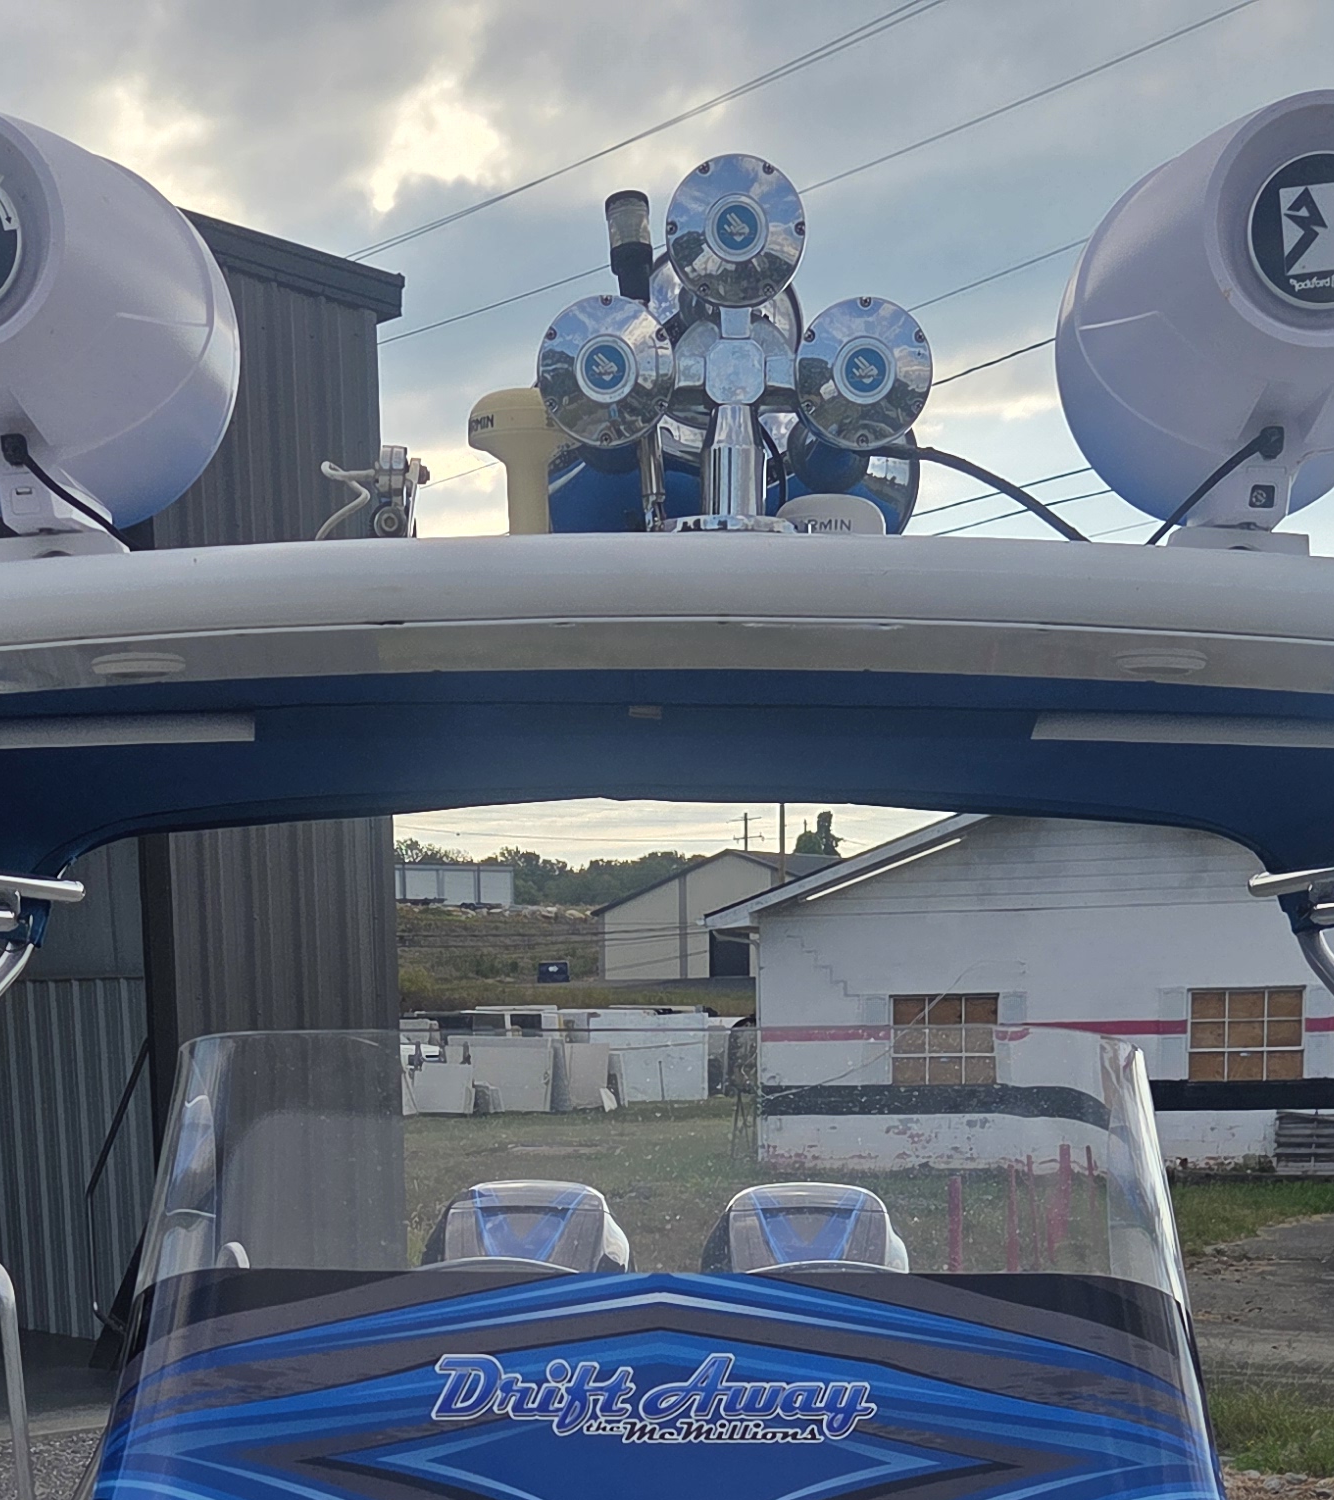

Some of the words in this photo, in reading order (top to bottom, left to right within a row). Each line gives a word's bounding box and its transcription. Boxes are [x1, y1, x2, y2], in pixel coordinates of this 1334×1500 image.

[430, 1352, 635, 1436] Drift
[638, 1352, 878, 1440] Away
[584, 1418, 624, 1434] the
